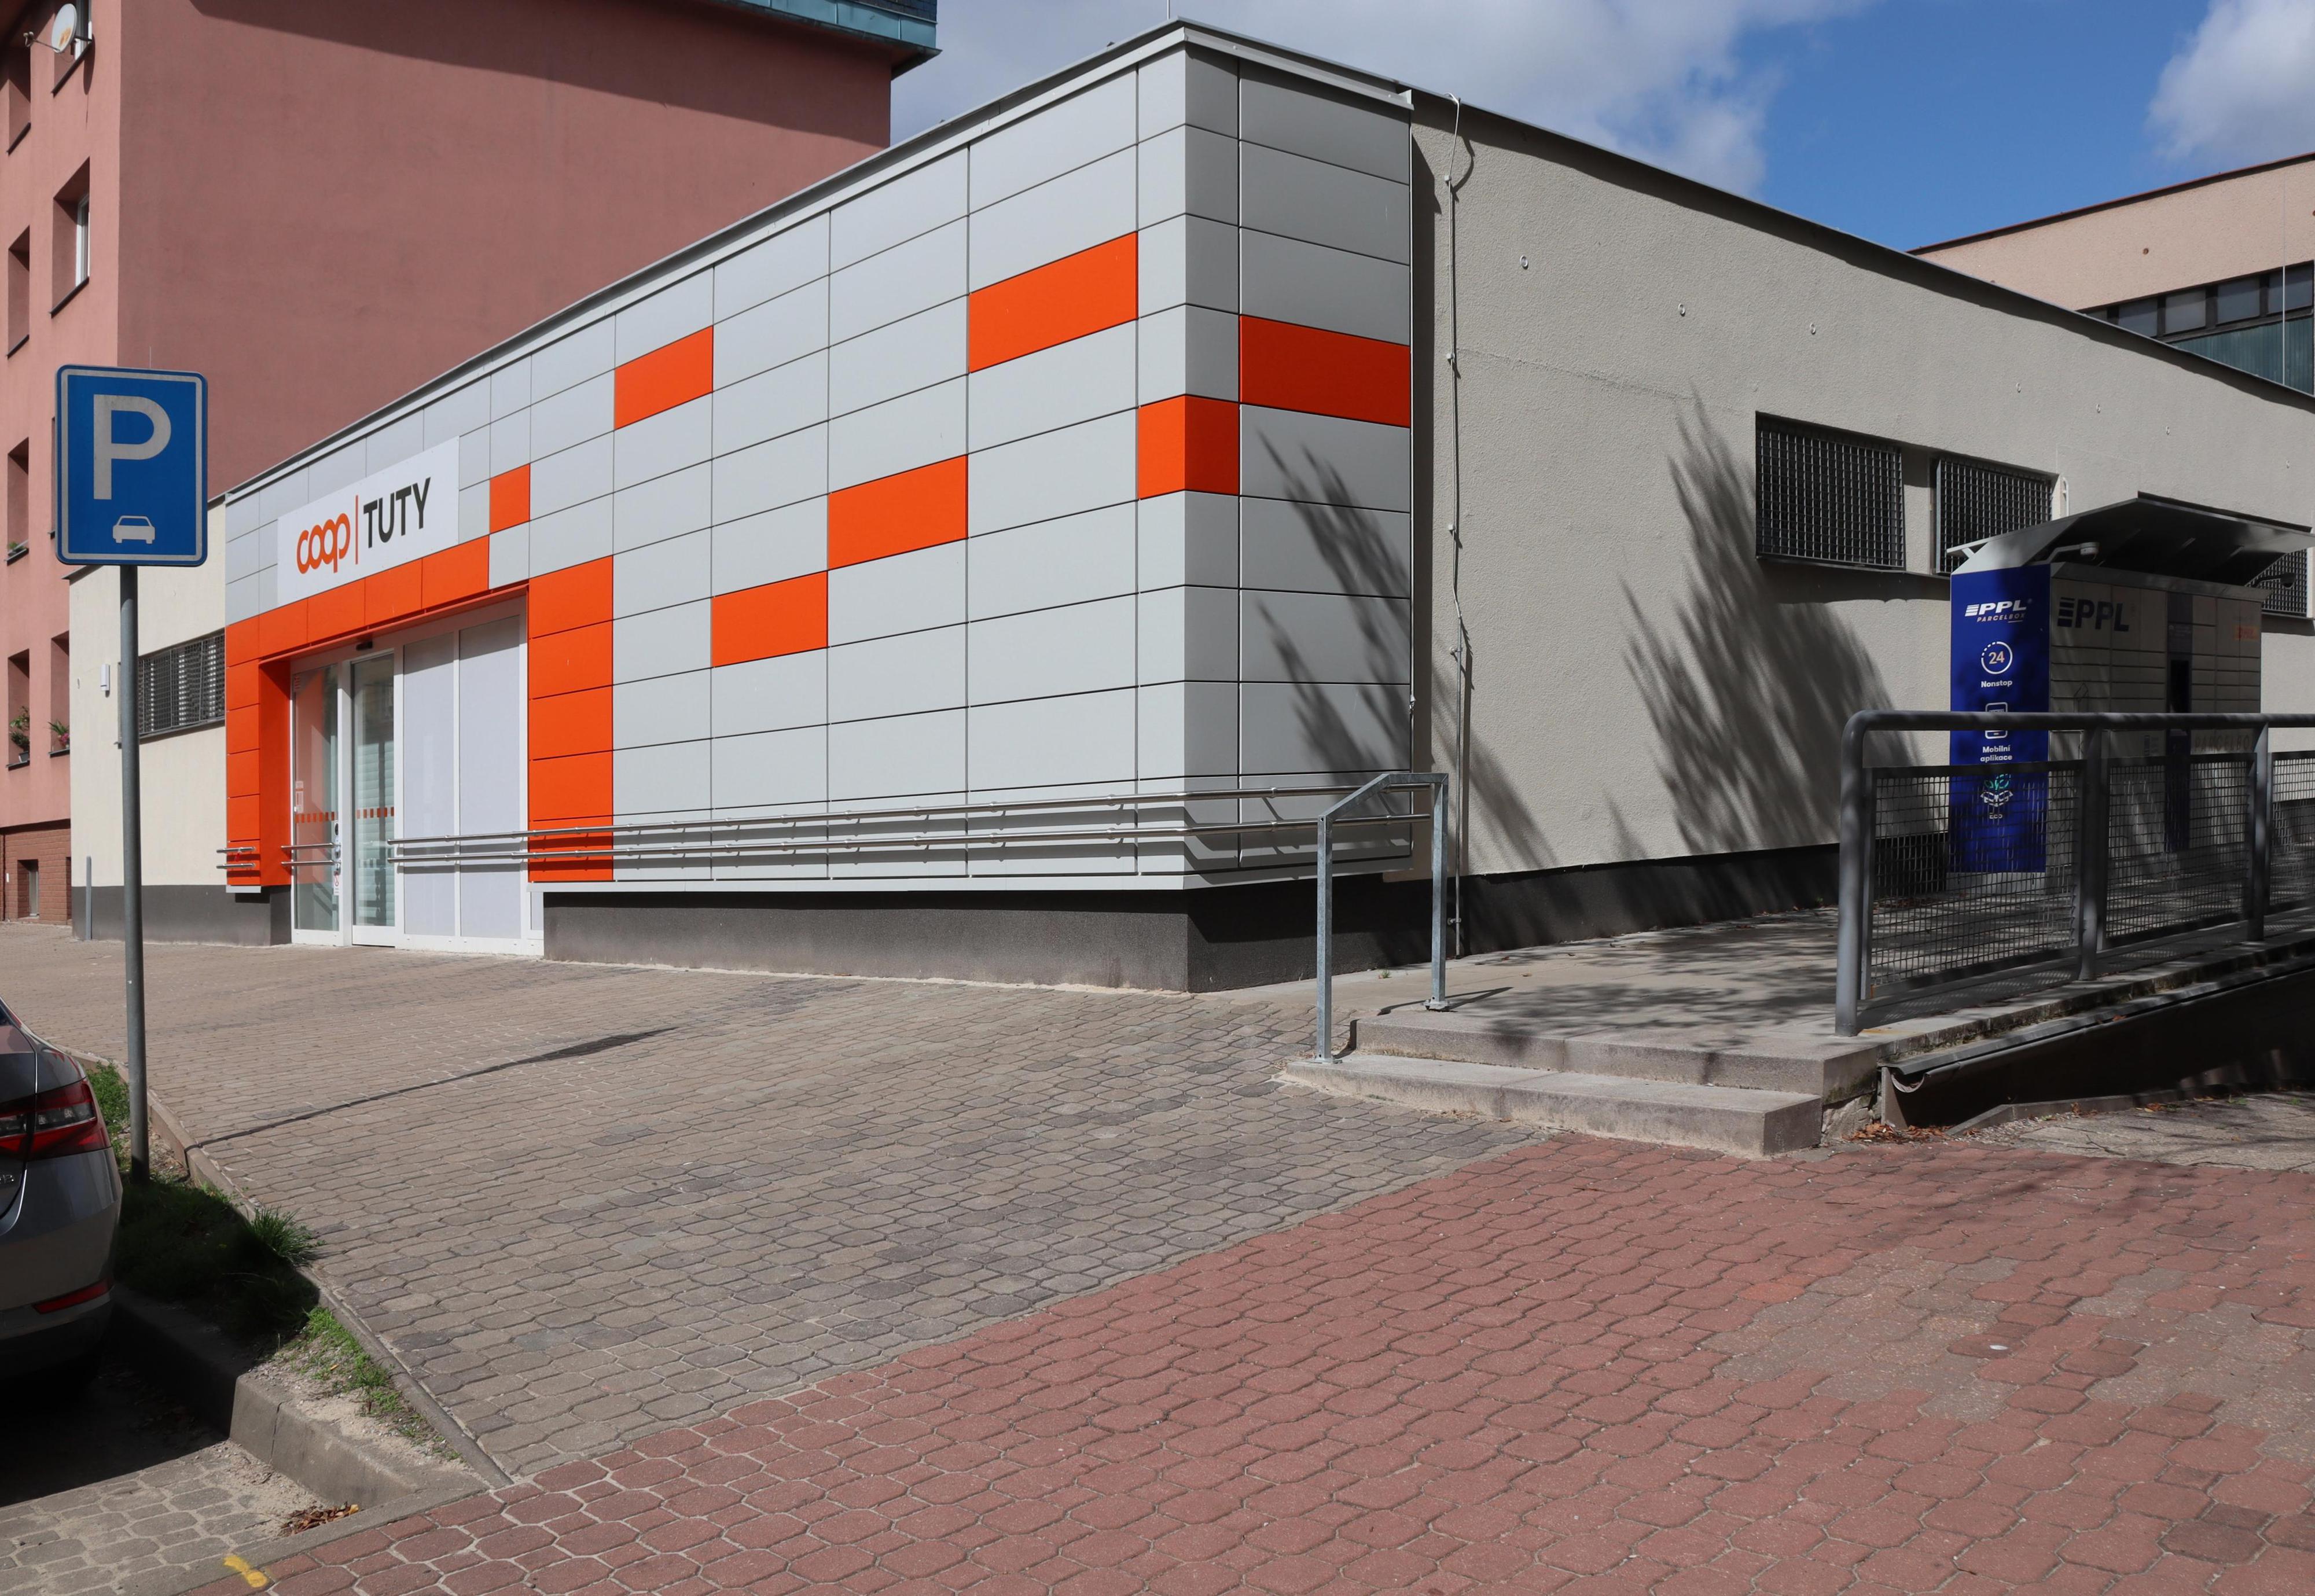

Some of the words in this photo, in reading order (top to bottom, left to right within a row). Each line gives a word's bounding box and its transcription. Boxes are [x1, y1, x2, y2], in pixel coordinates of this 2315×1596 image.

[93, 394, 171, 500] P
[297, 513, 351, 573] coop
[363, 477, 431, 548] TUTY
[1977, 613, 2026, 622] PARCELBOX
[1989, 651, 2005, 664] 24
[1982, 745, 2011, 753] Mobilní
[2195, 734, 2251, 751] PARCELBO
[1980, 755, 2012, 763] aplikace
